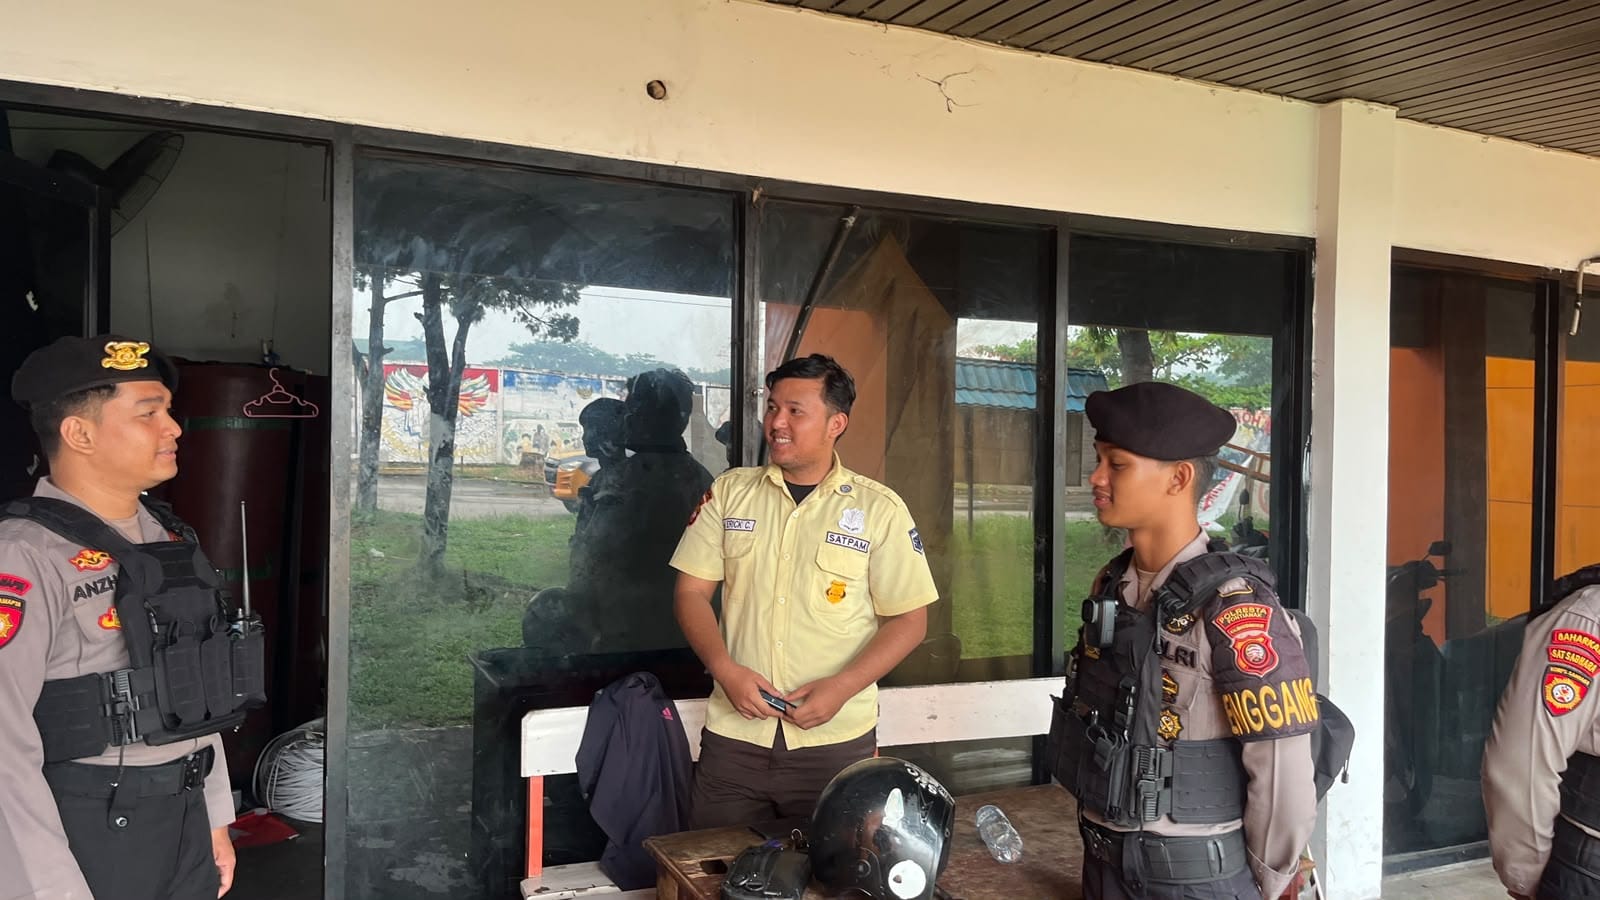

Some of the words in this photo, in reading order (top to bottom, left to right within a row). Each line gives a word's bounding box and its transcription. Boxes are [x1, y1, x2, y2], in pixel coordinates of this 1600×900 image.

[829, 534, 867, 550] SATPAM
[1218, 606, 1267, 624] POLRESTA
[1558, 633, 1600, 655] BAHARKA
[1551, 649, 1566, 659] SAT
